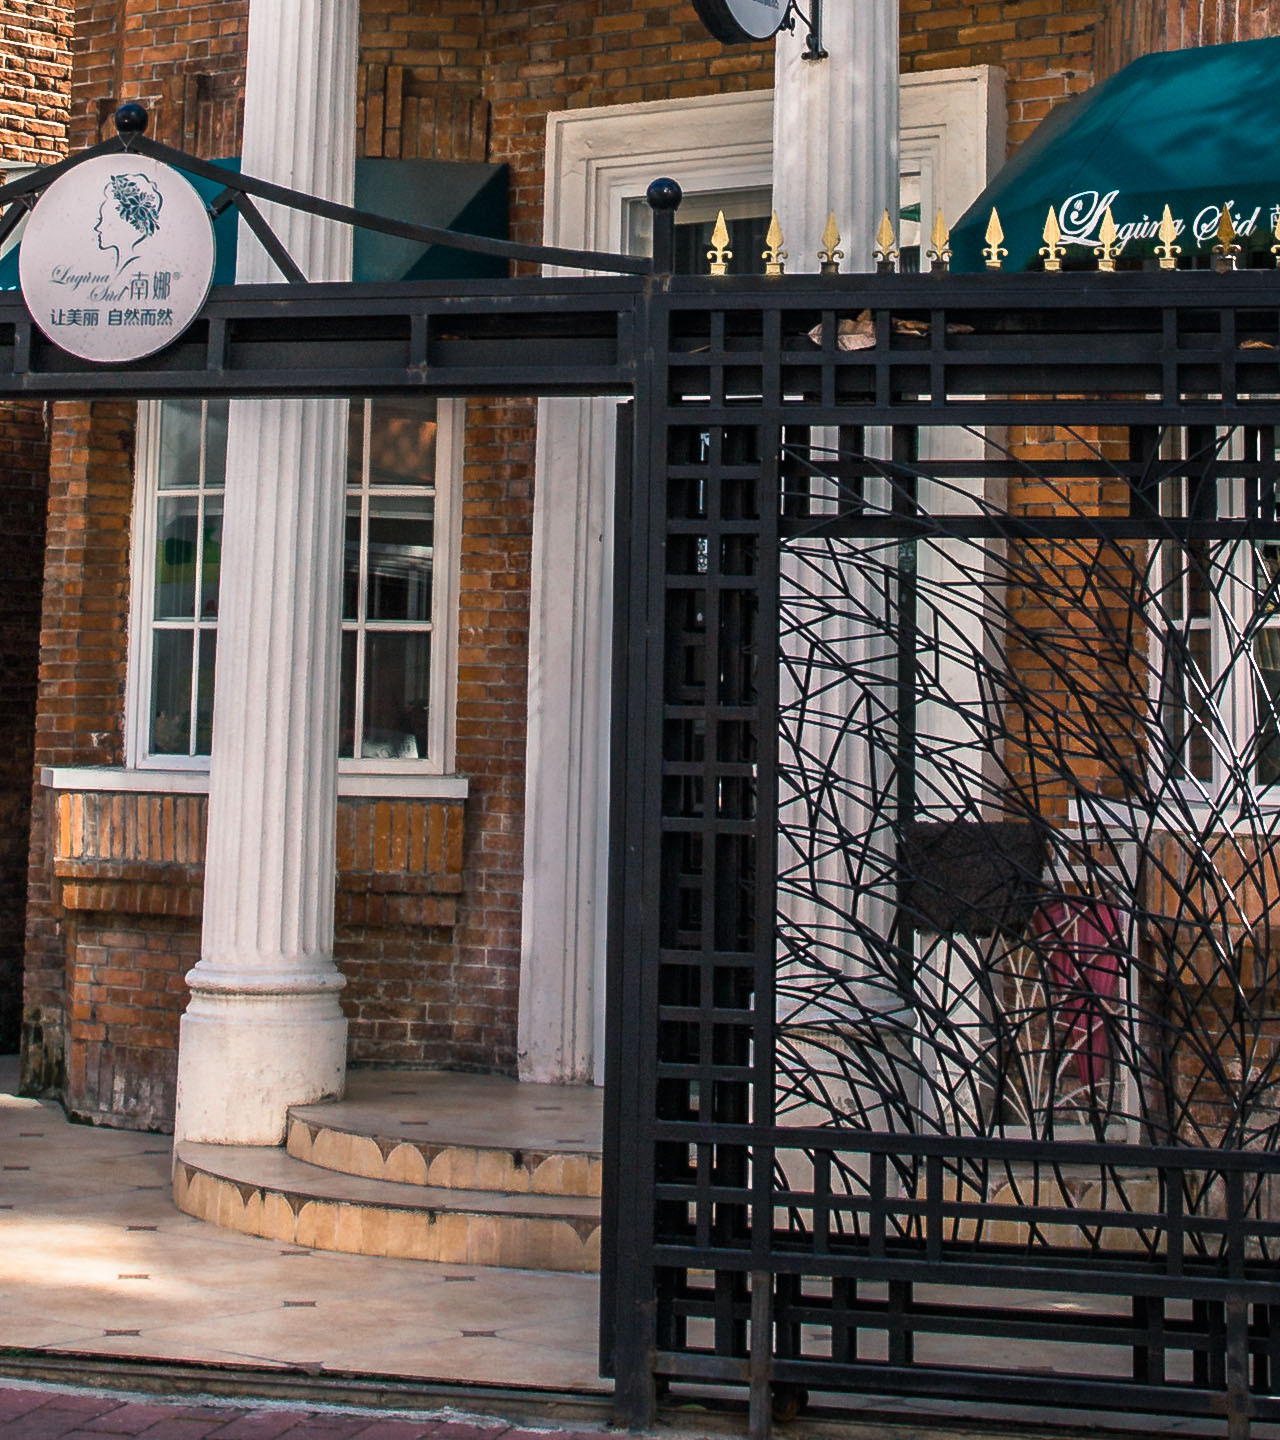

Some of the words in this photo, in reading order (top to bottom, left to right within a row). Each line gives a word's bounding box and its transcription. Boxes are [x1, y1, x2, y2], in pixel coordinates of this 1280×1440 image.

[50, 308, 99, 326] 让美丽
[107, 308, 173, 326] 自然而然
